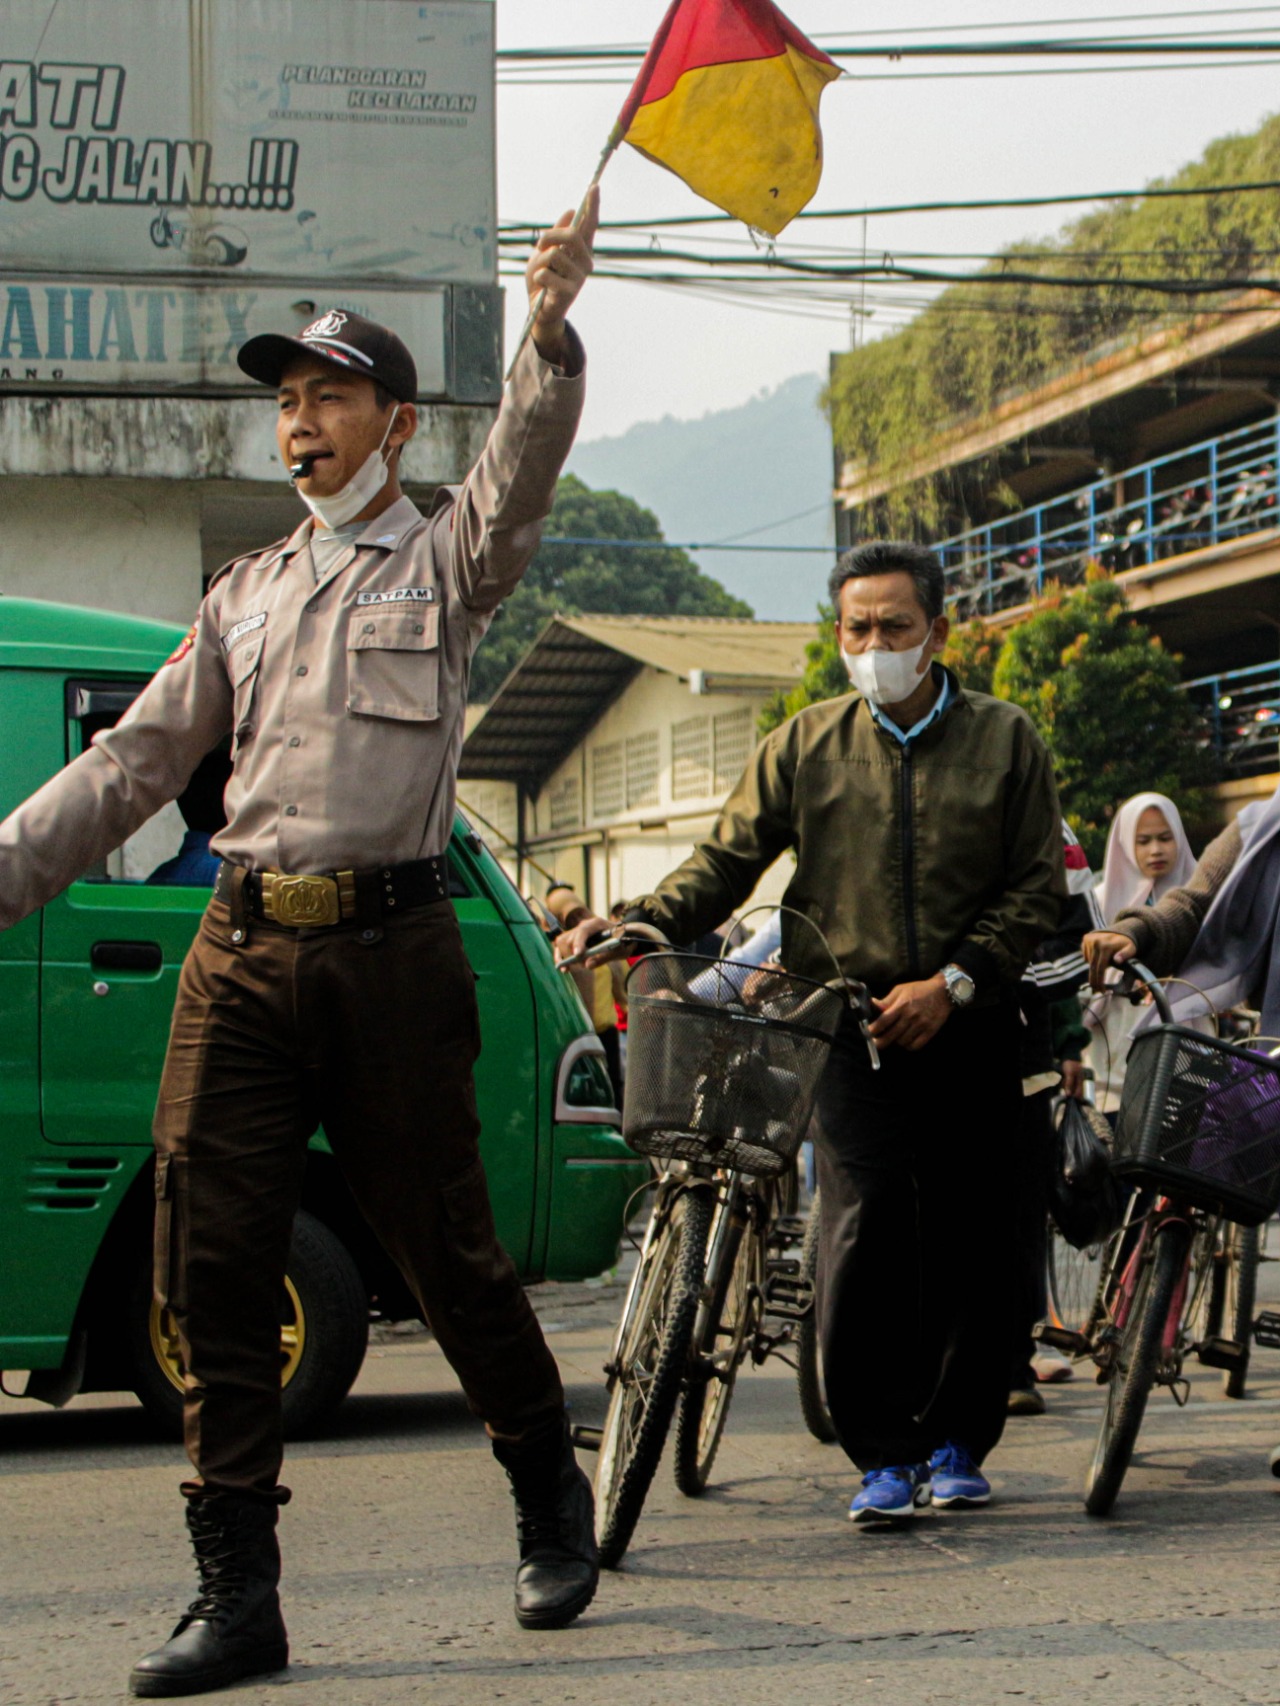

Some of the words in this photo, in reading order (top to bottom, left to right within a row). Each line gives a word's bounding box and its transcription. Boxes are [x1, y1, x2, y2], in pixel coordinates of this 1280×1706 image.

[282, 64, 426, 88] PELANGGARAN
[347, 89, 477, 113] KECELAKAAN
[362, 588, 429, 603] SATPAM
